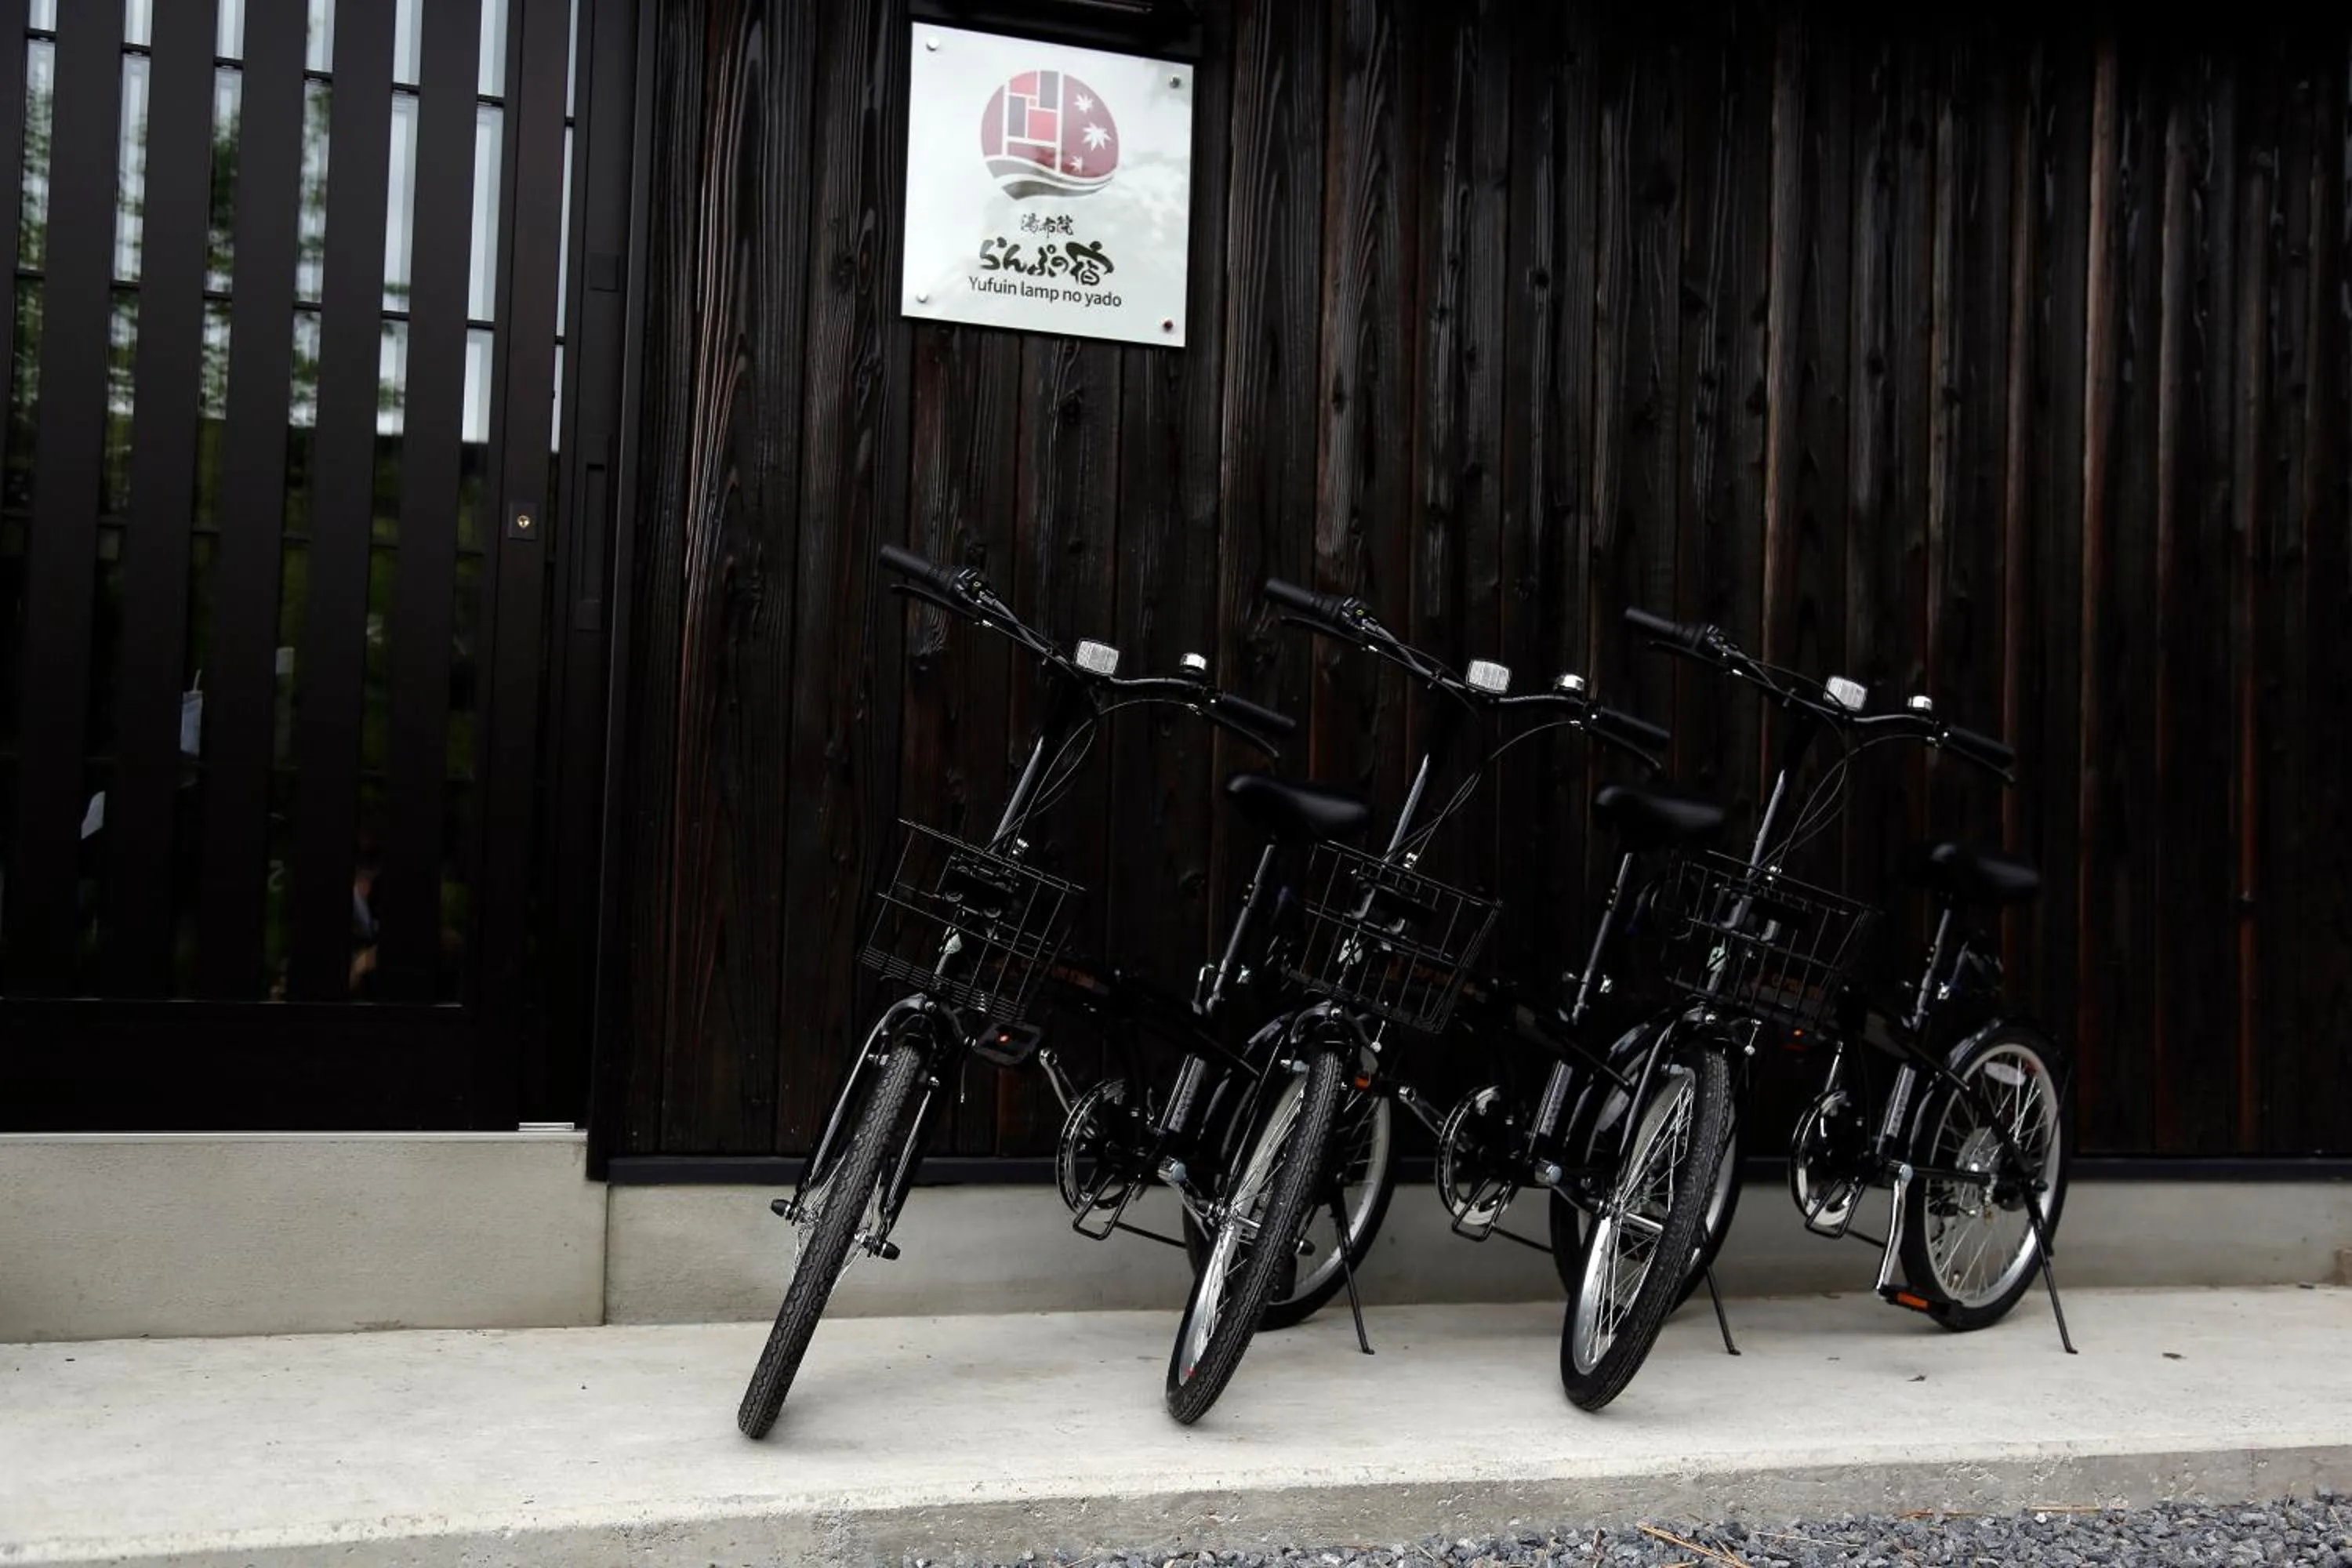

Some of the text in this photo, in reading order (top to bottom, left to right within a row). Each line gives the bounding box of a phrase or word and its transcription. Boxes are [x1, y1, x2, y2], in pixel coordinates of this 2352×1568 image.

[979, 237, 1114, 286] らんぷの宿
[968, 275, 1122, 307] Yufuin lamp no yado
